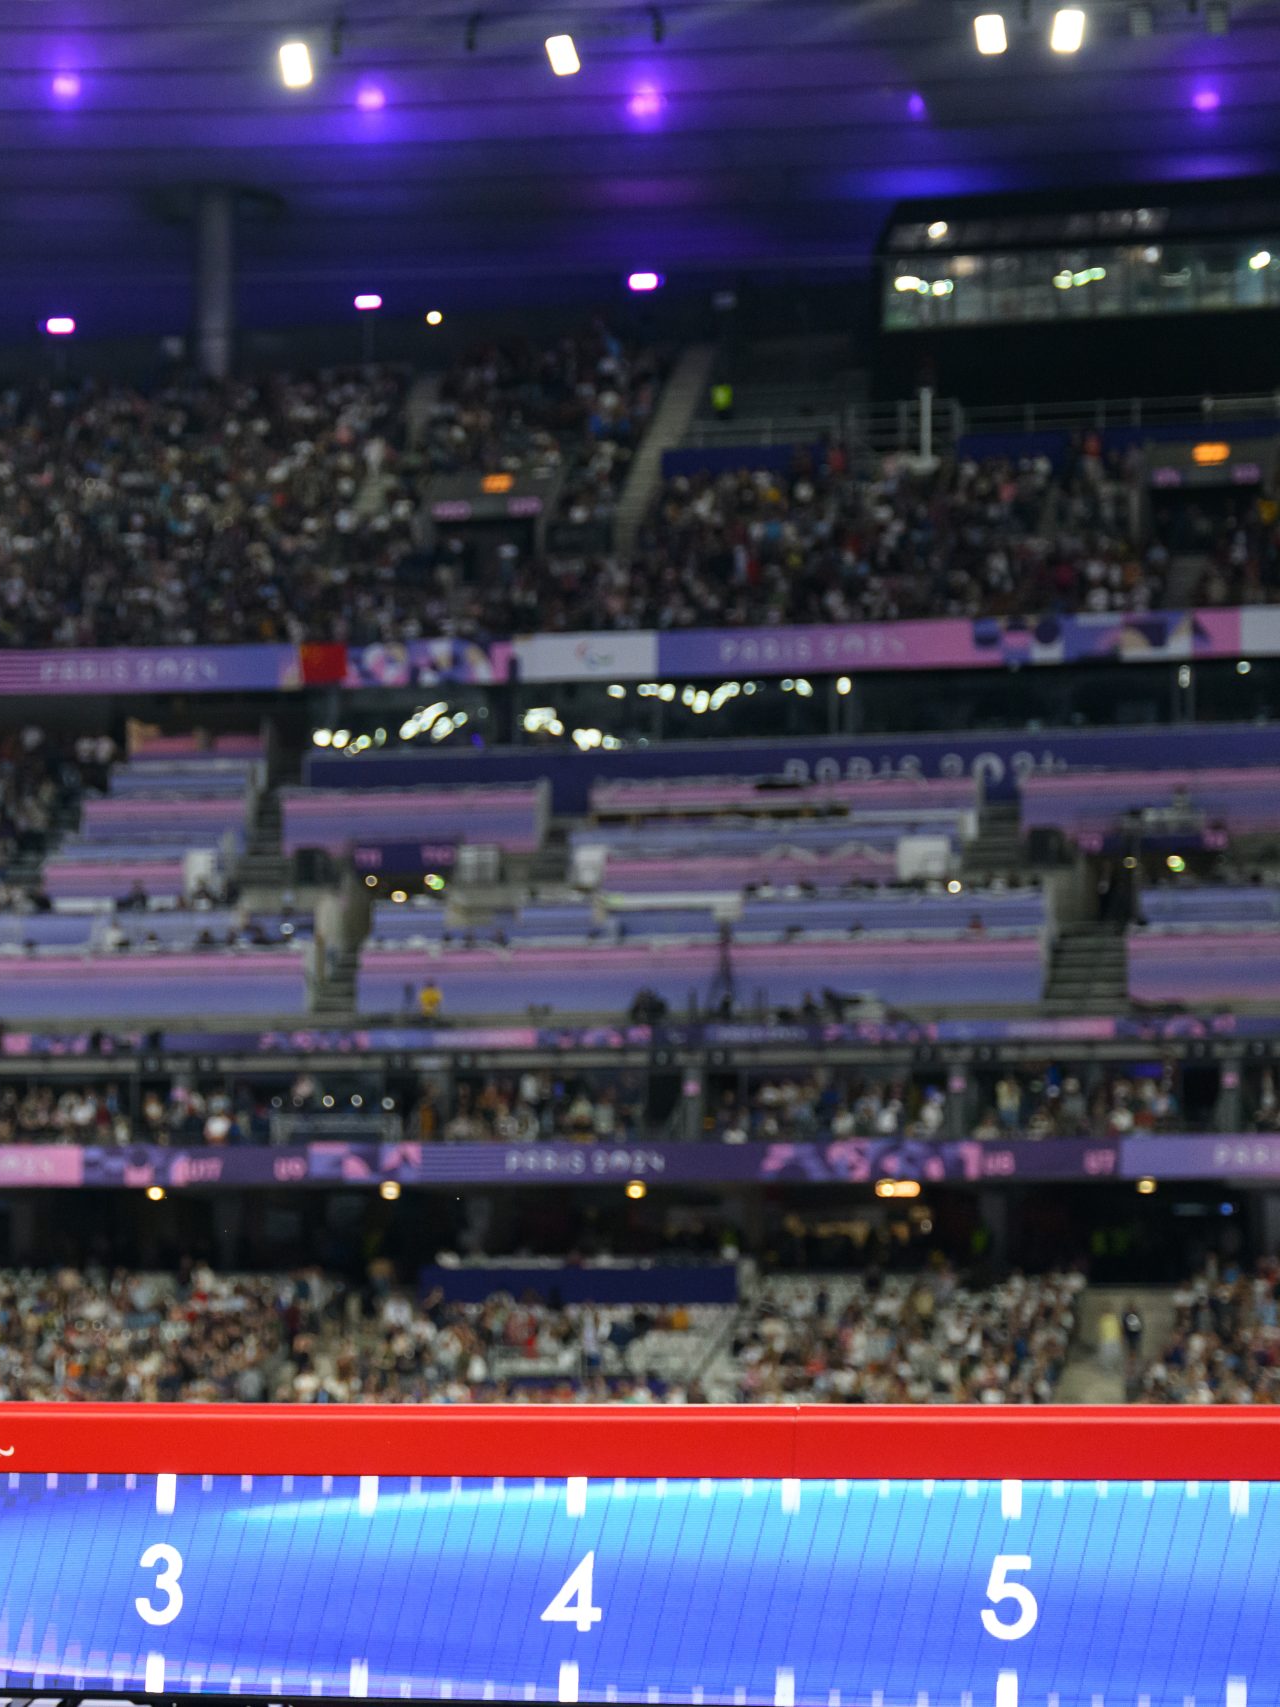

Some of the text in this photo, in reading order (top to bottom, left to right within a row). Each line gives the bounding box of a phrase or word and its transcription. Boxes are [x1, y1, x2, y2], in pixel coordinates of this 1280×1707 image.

[40, 657, 220, 684] PARIS 2024
[505, 1150, 665, 1175] PARIS 2024
[1212, 1142, 1280, 1168] PAR
[135, 1543, 1038, 1640] 3 4 5
